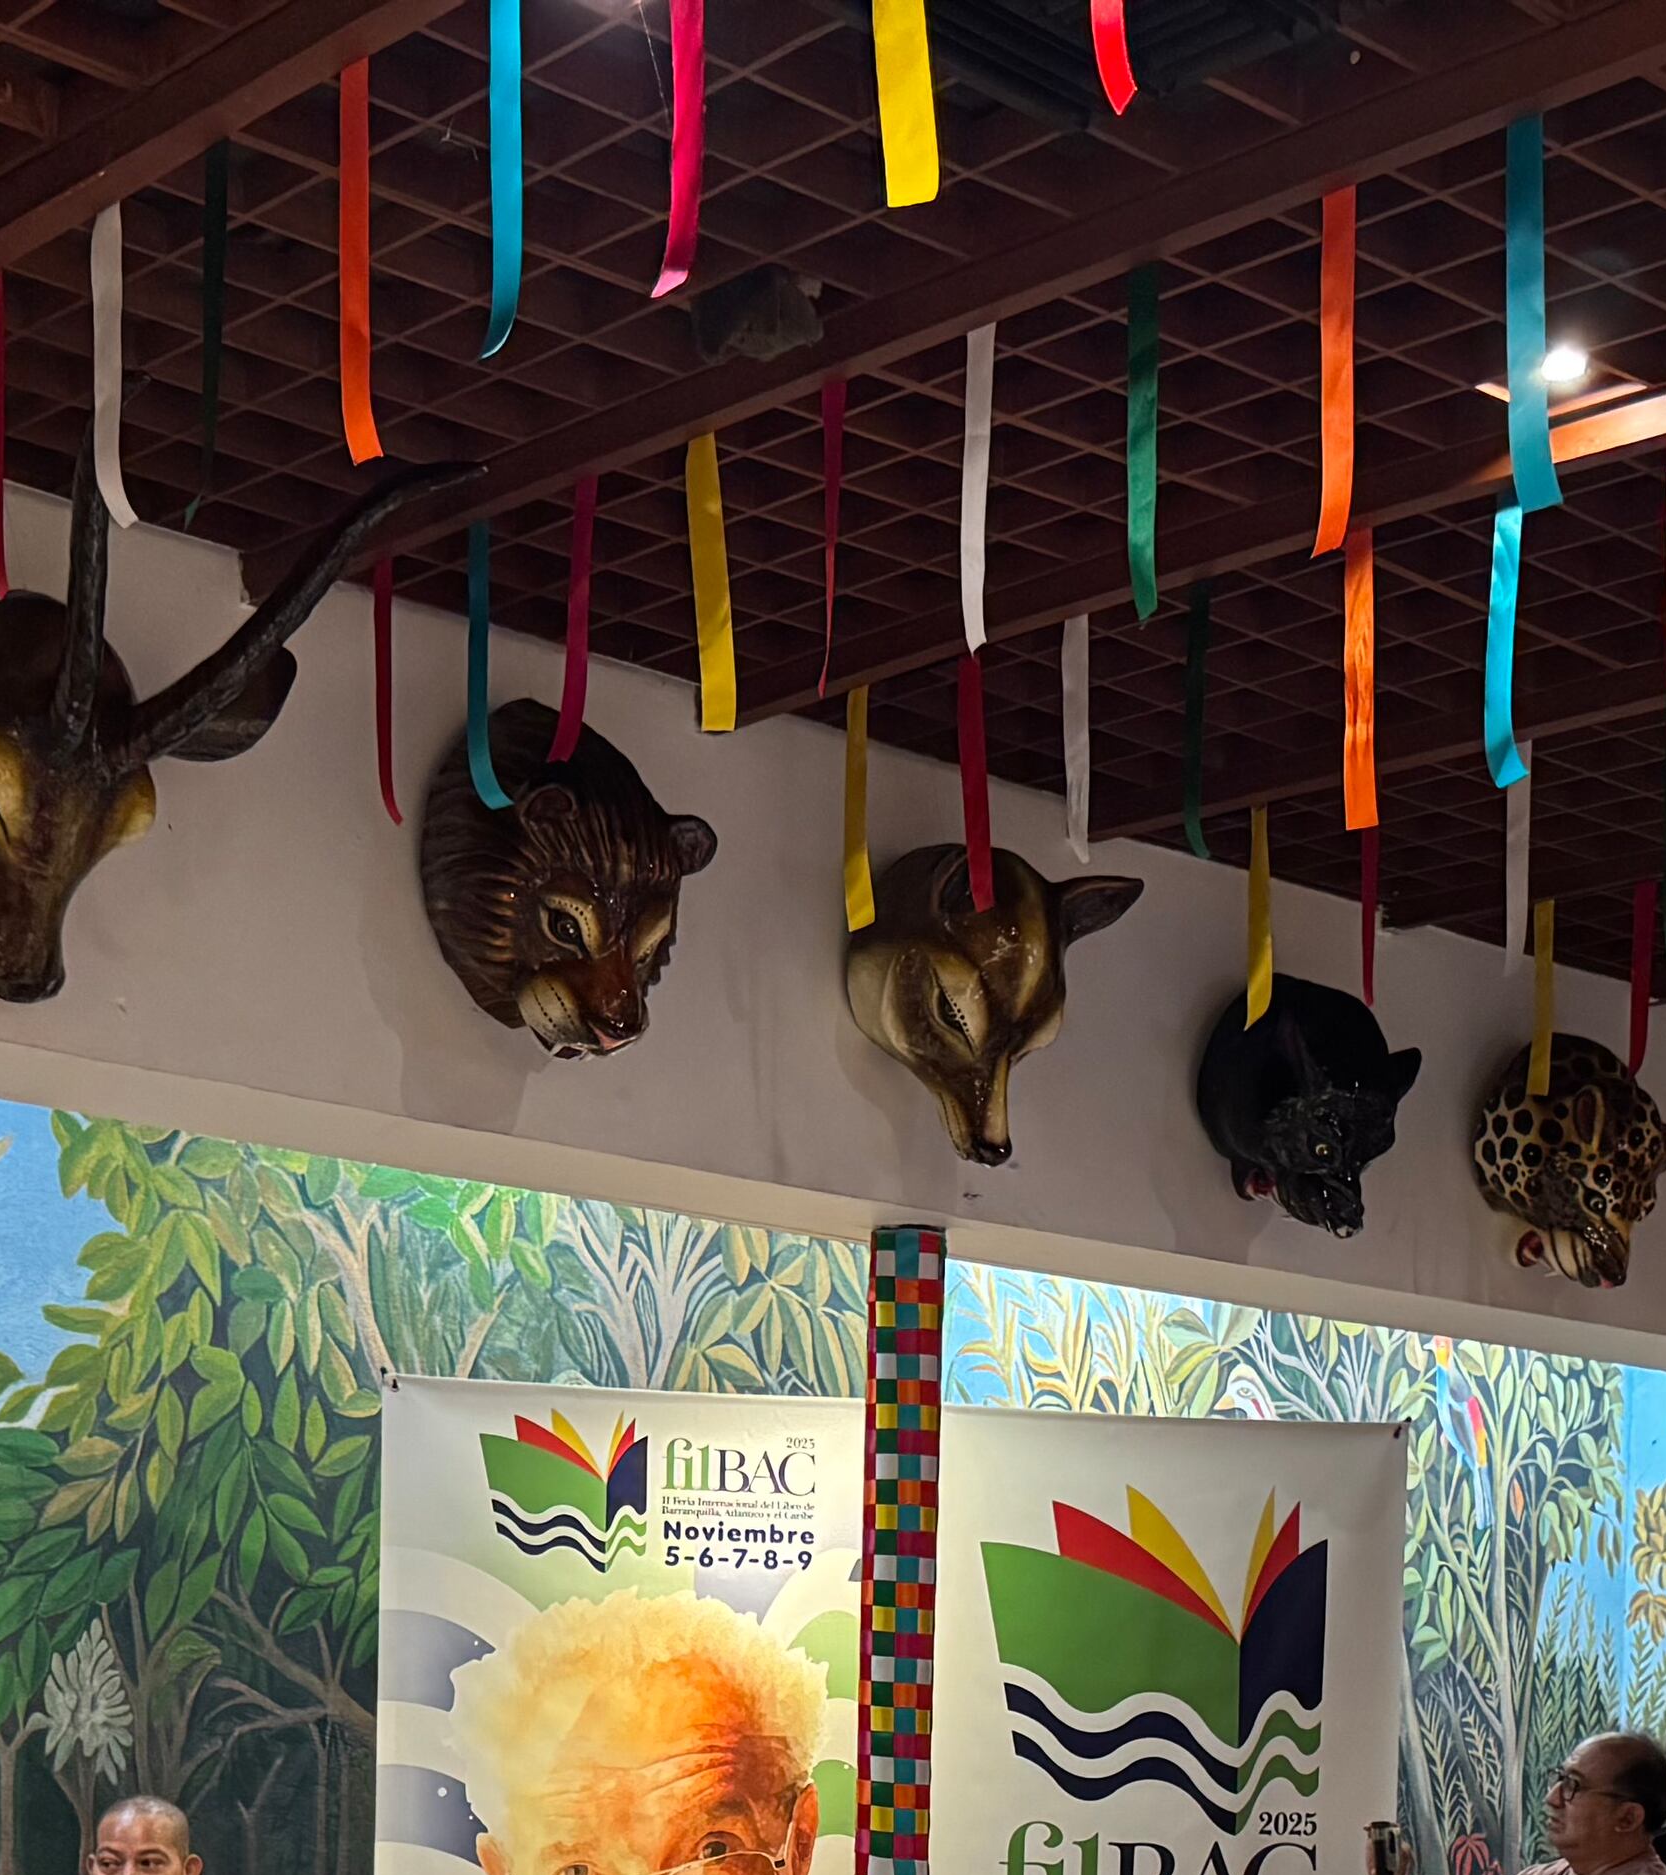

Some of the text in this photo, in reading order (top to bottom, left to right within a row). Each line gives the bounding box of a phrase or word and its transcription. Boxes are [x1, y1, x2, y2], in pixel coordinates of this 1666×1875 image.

[785, 1436, 816, 1449] 2025
[662, 1496, 815, 1511] II Feria Internacional del Libro de
[784, 1511, 814, 1520] Caribe
[663, 1520, 815, 1545] Noviembre
[1258, 1811, 1318, 1837] 2025
